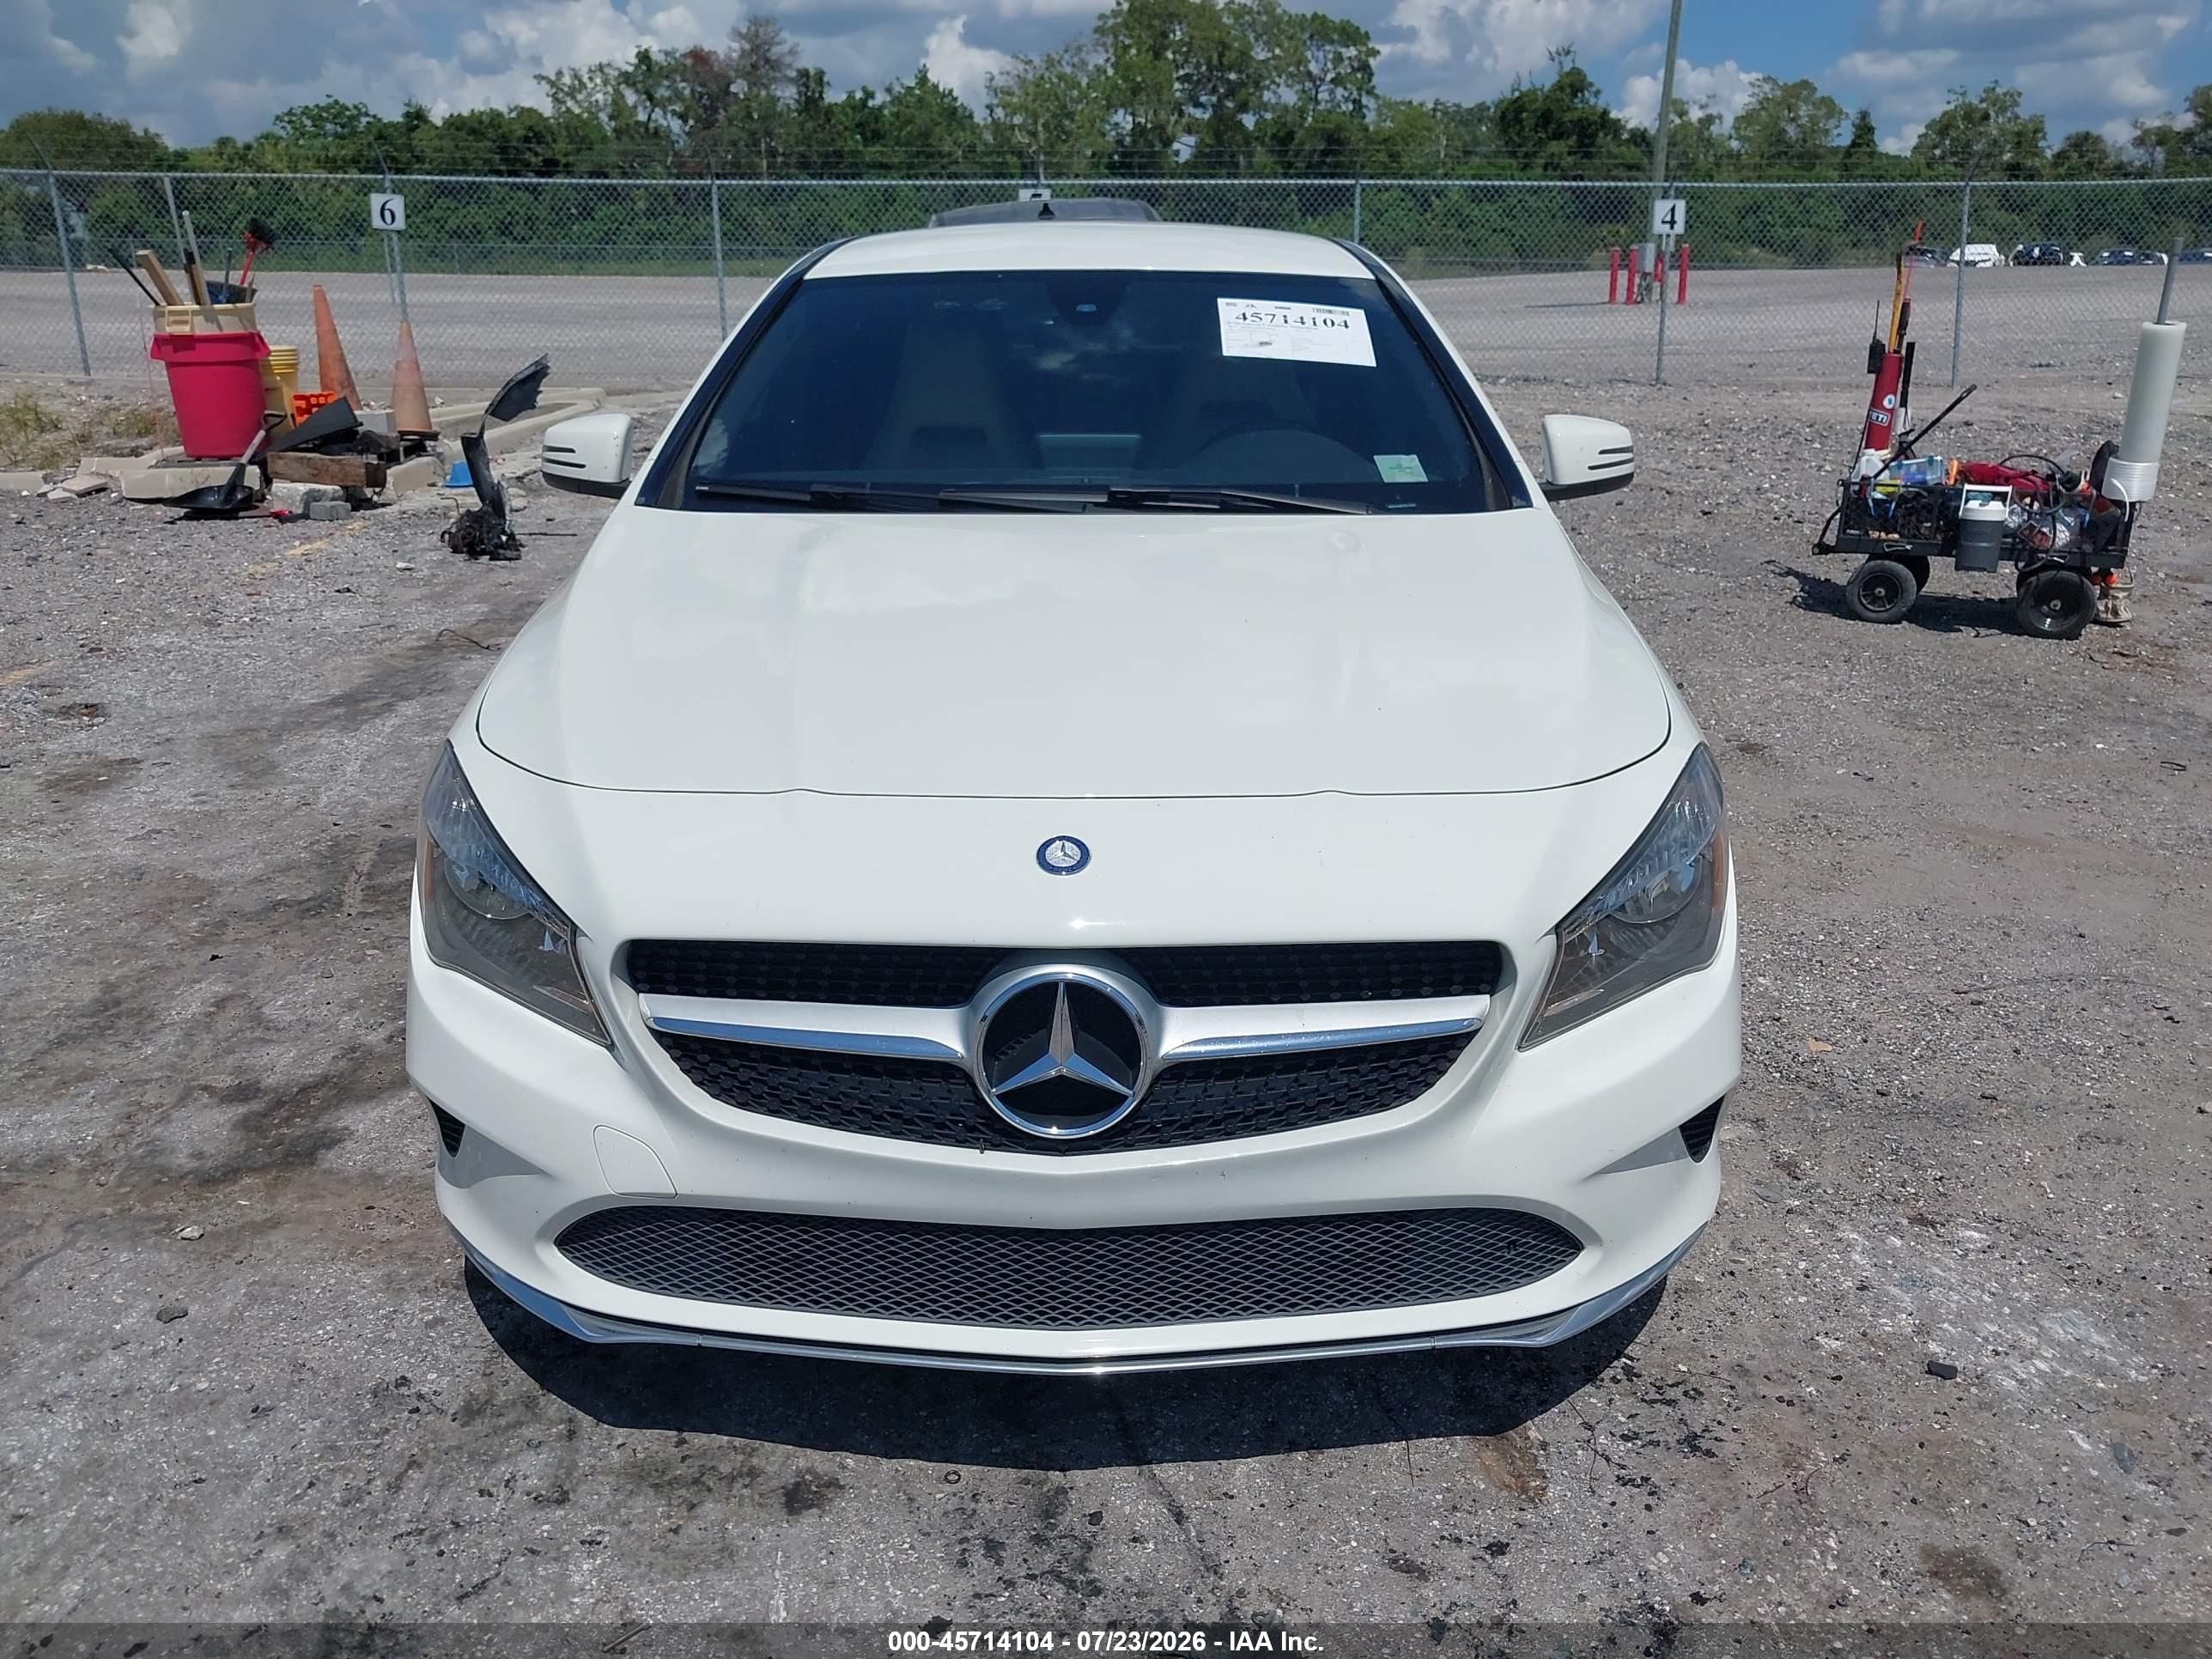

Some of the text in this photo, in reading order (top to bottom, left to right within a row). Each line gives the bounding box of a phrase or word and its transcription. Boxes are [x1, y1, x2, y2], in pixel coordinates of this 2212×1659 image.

[380, 198, 396, 226] 6
[1661, 203, 1677, 231] 4
[1235, 311, 1351, 330] 45714104
